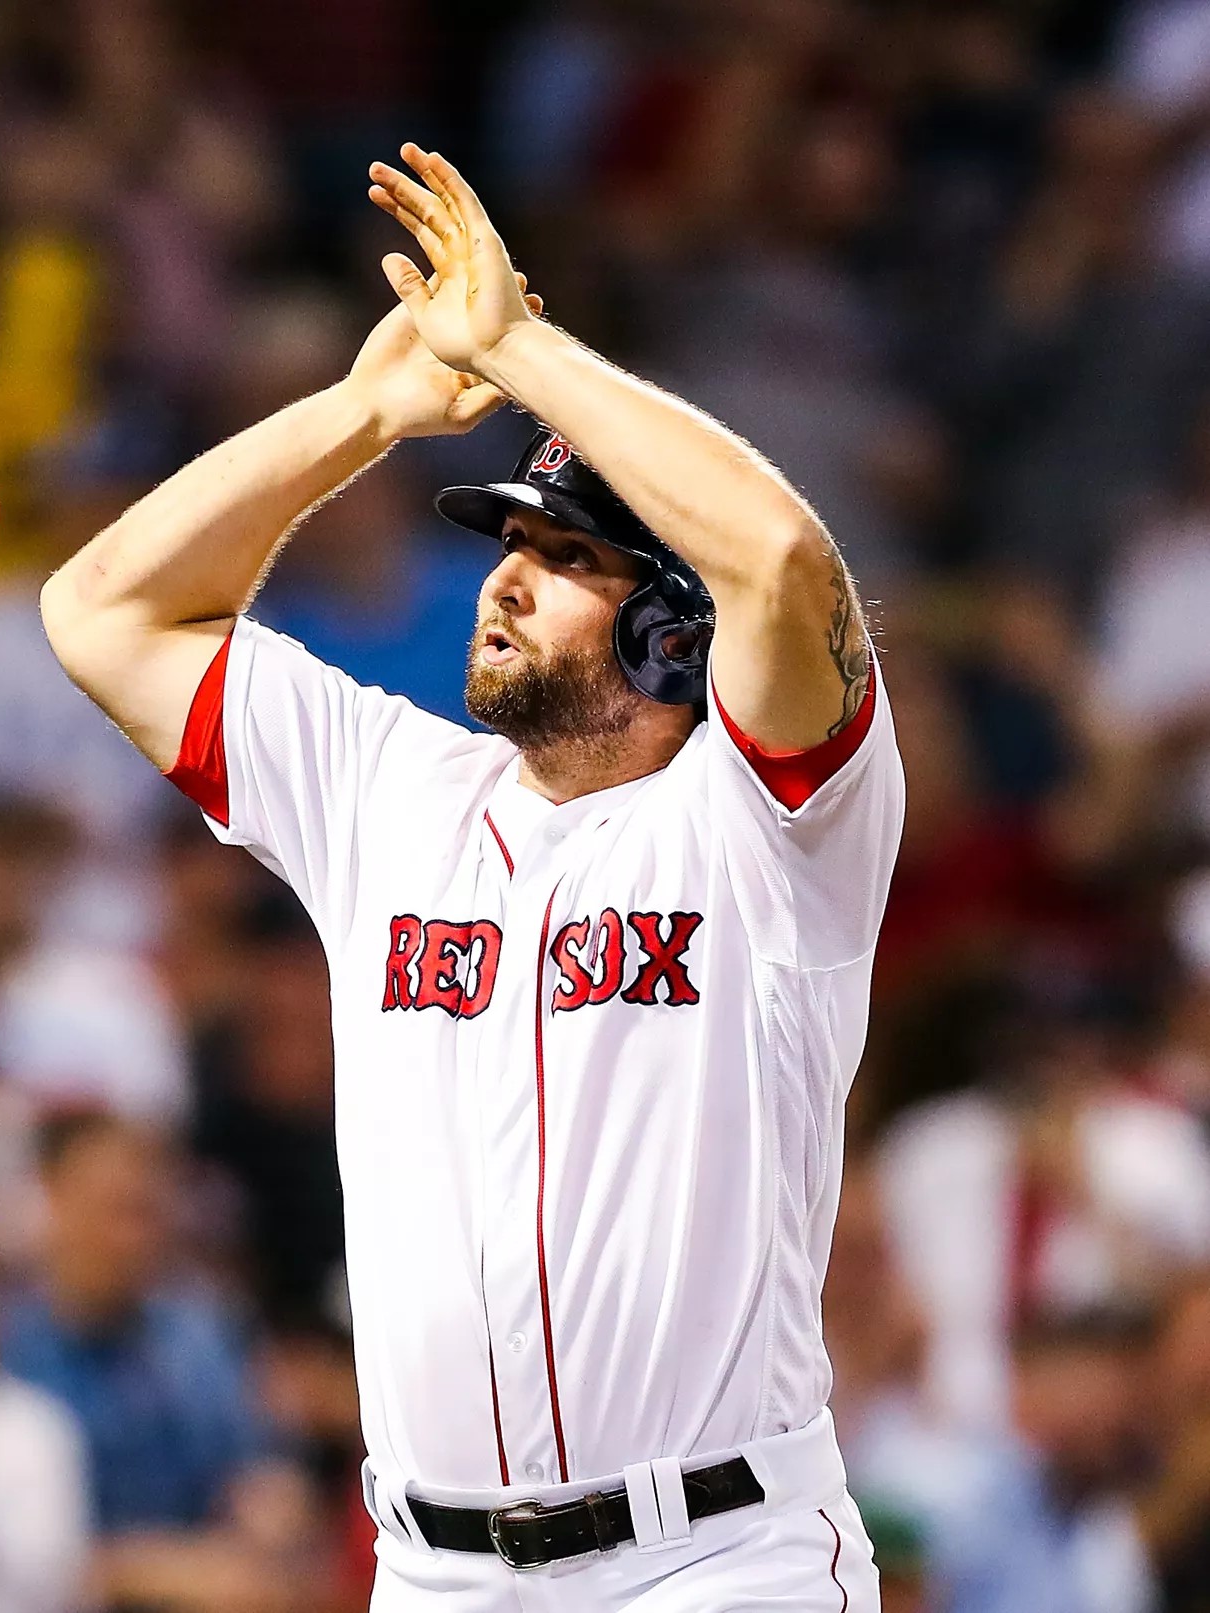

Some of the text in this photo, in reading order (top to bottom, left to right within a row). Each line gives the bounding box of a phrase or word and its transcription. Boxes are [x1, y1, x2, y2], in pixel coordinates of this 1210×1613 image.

[531, 432, 571, 473] B
[382, 907, 704, 1021] RED SOX
